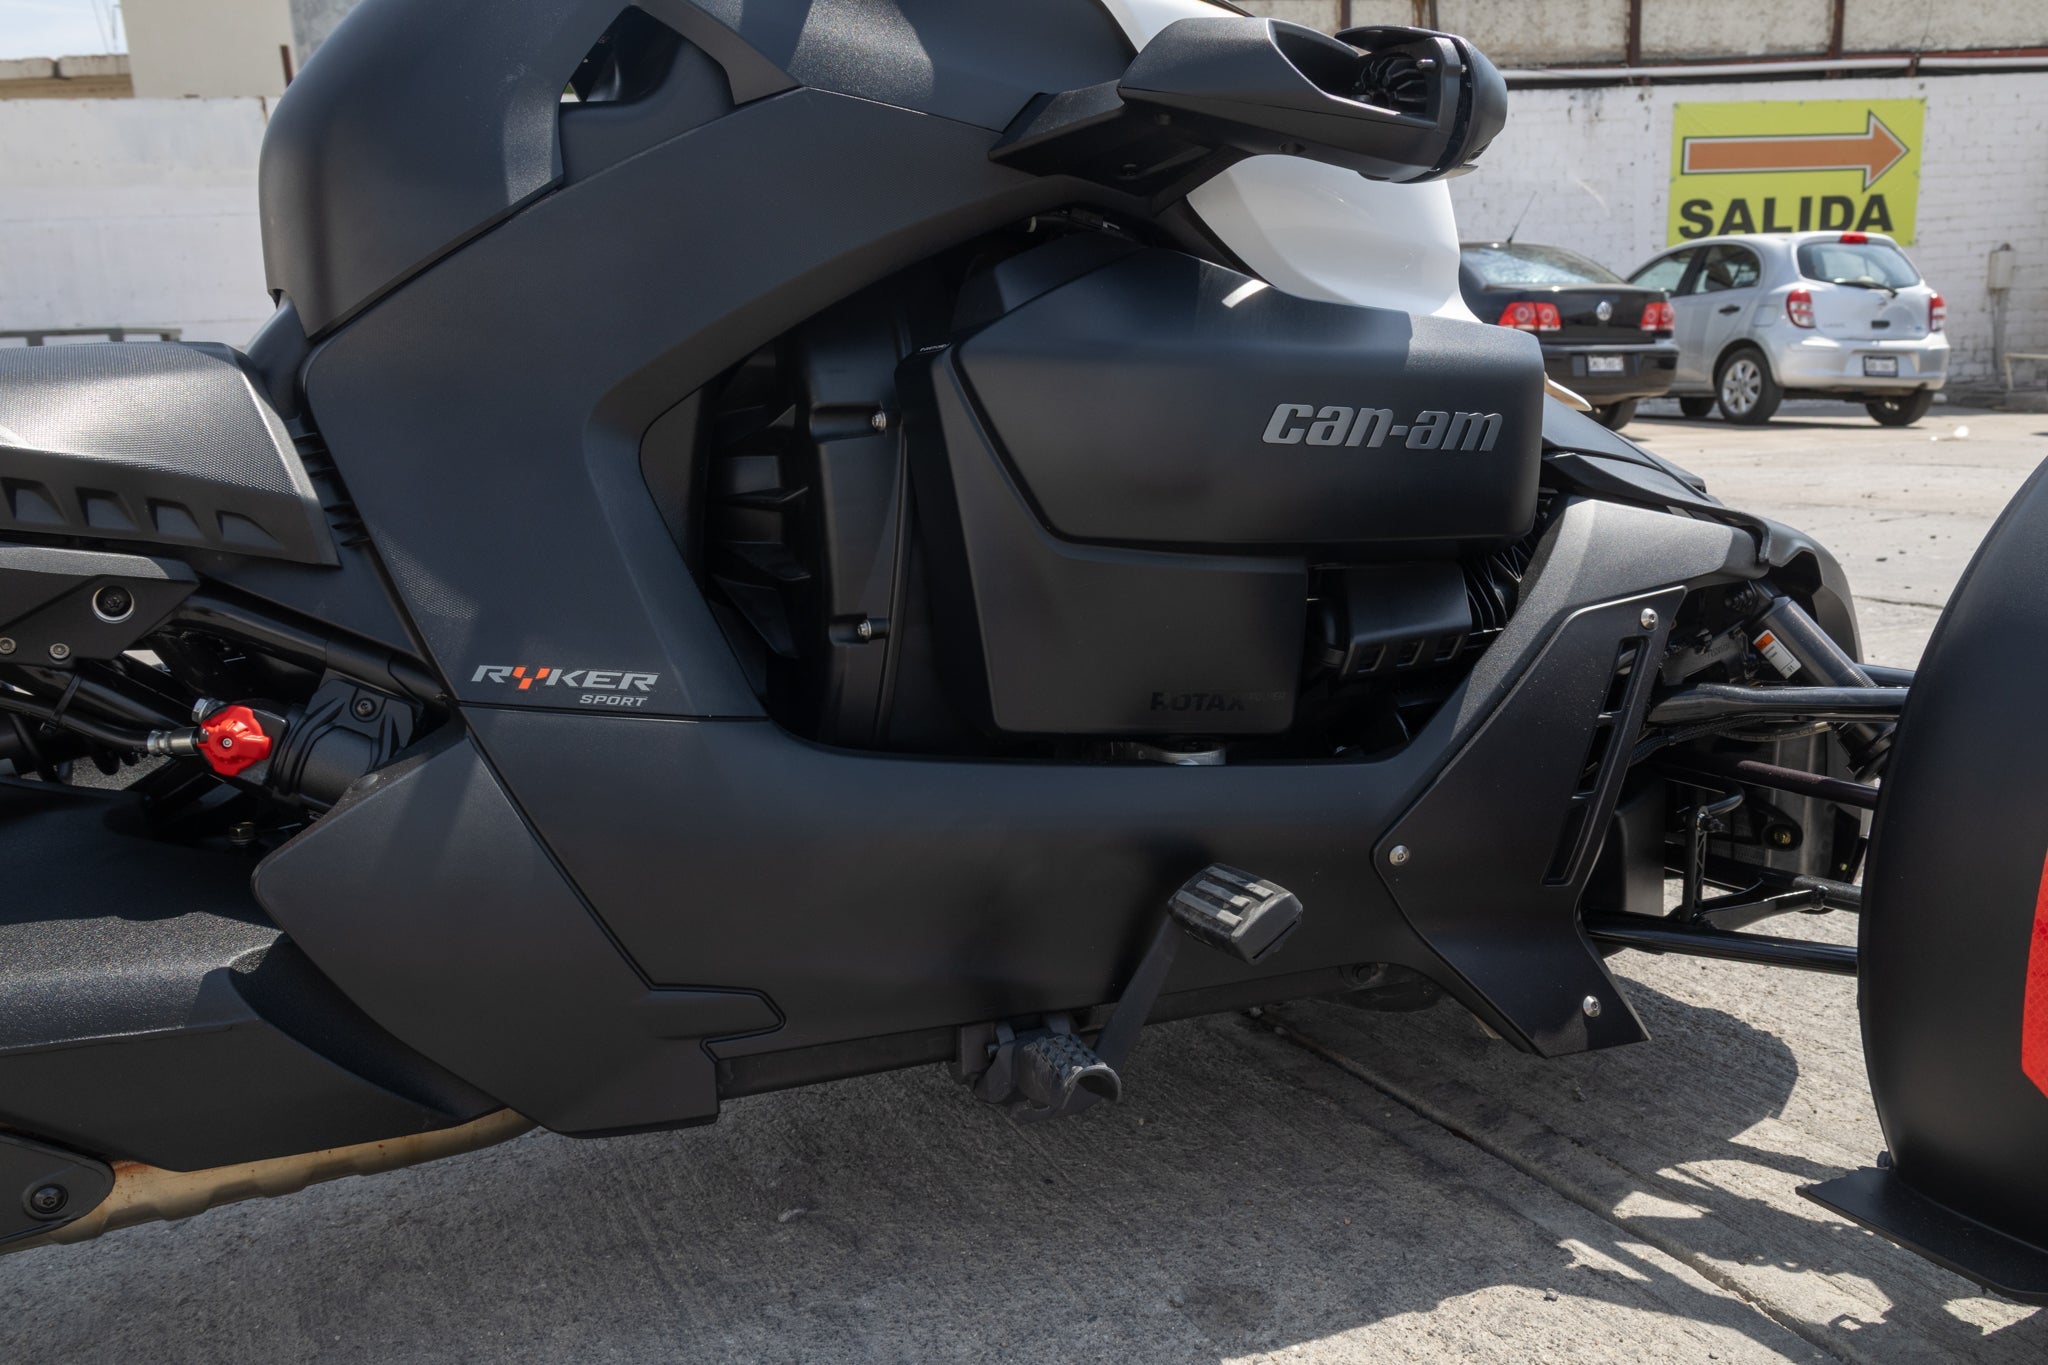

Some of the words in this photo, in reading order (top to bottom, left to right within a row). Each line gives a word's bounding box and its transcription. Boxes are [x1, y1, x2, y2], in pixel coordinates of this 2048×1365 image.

[1678, 194, 1894, 239] SALIDA
[470, 664, 660, 692] RYKER
[579, 694, 649, 707] SPORT
